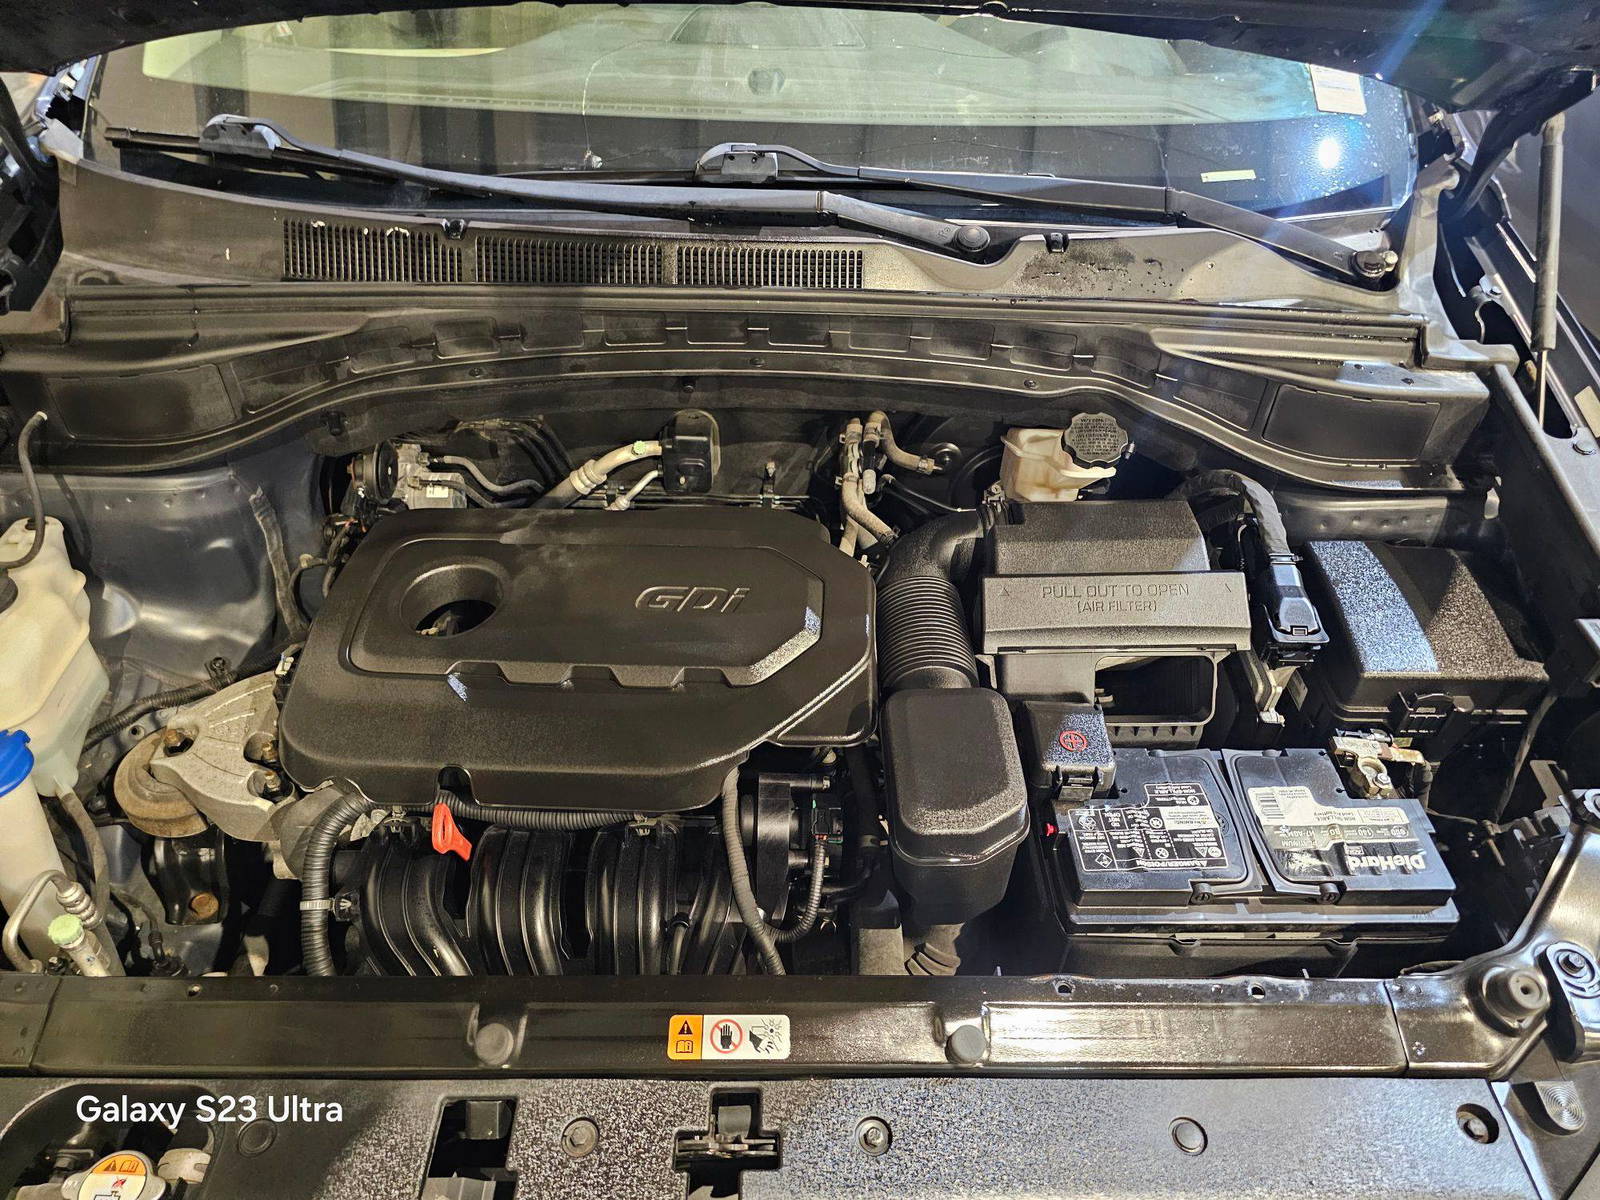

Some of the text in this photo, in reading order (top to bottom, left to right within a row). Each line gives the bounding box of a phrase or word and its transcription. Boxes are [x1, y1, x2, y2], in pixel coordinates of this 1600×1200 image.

[1042, 582, 1190, 599] PULL OUT TO OPEN
[1077, 600, 1157, 614] (AIR FILTER)
[1347, 854, 1426, 870] DieHard
